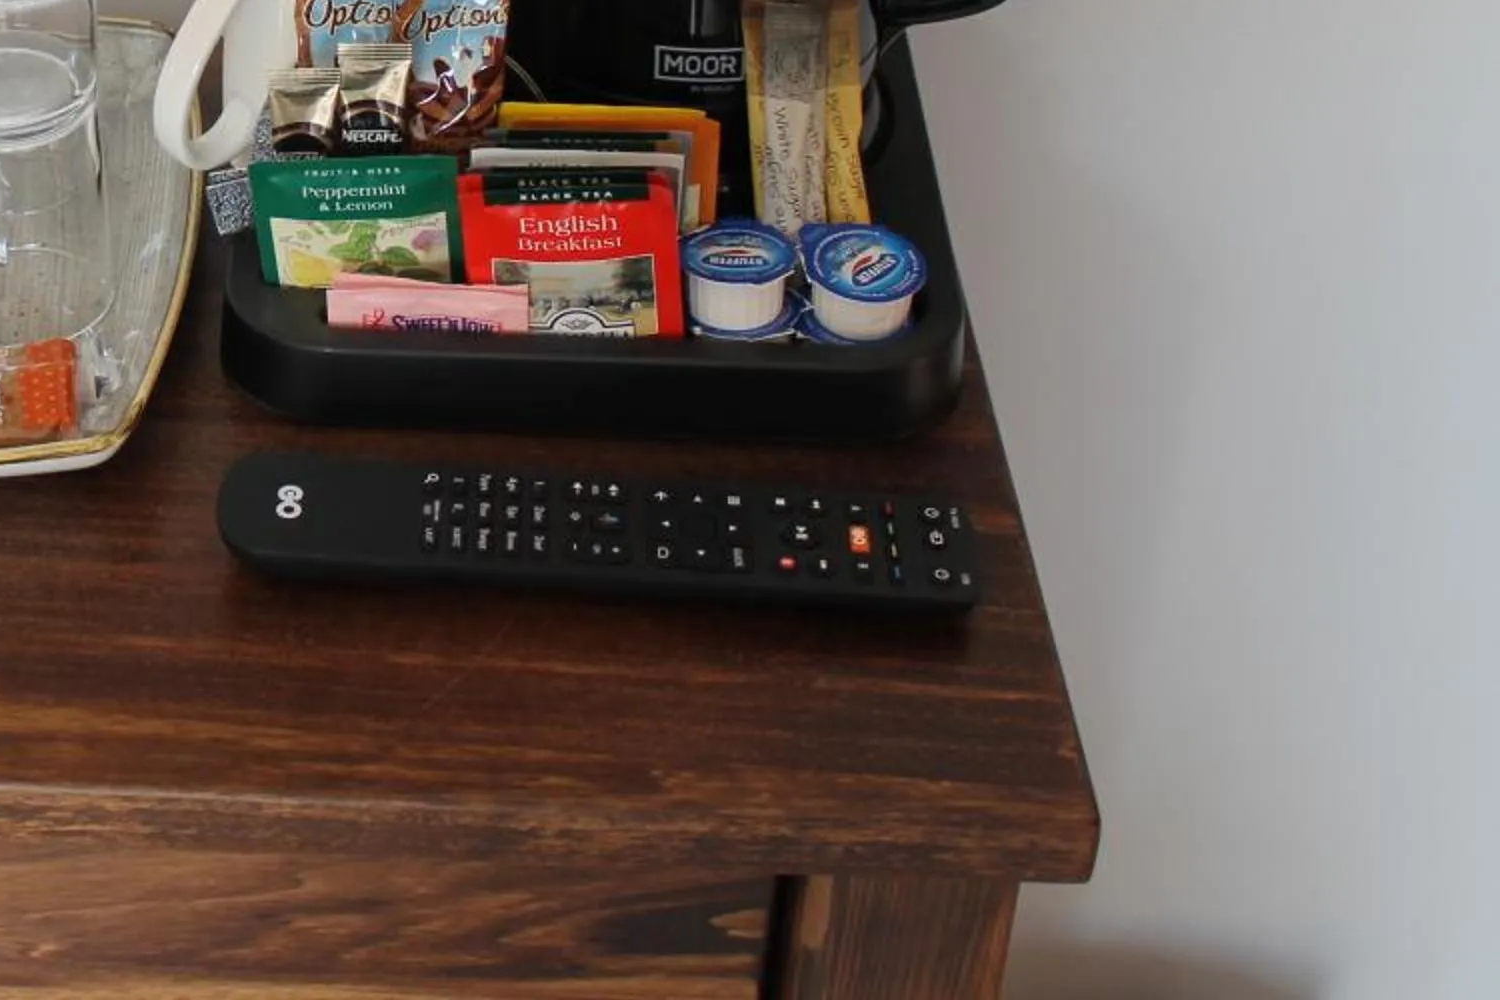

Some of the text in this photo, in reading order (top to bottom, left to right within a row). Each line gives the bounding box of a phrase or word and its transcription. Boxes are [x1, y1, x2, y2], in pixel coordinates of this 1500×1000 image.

[663, 53, 738, 76] MOOR
[302, 183, 407, 199] Peppermint
[518, 190, 613, 201] BLACK TEA
[319, 200, 393, 212] & Lemon
[518, 214, 619, 235] English
[517, 235, 622, 252] Breakfast
[275, 484, 305, 520] GO
